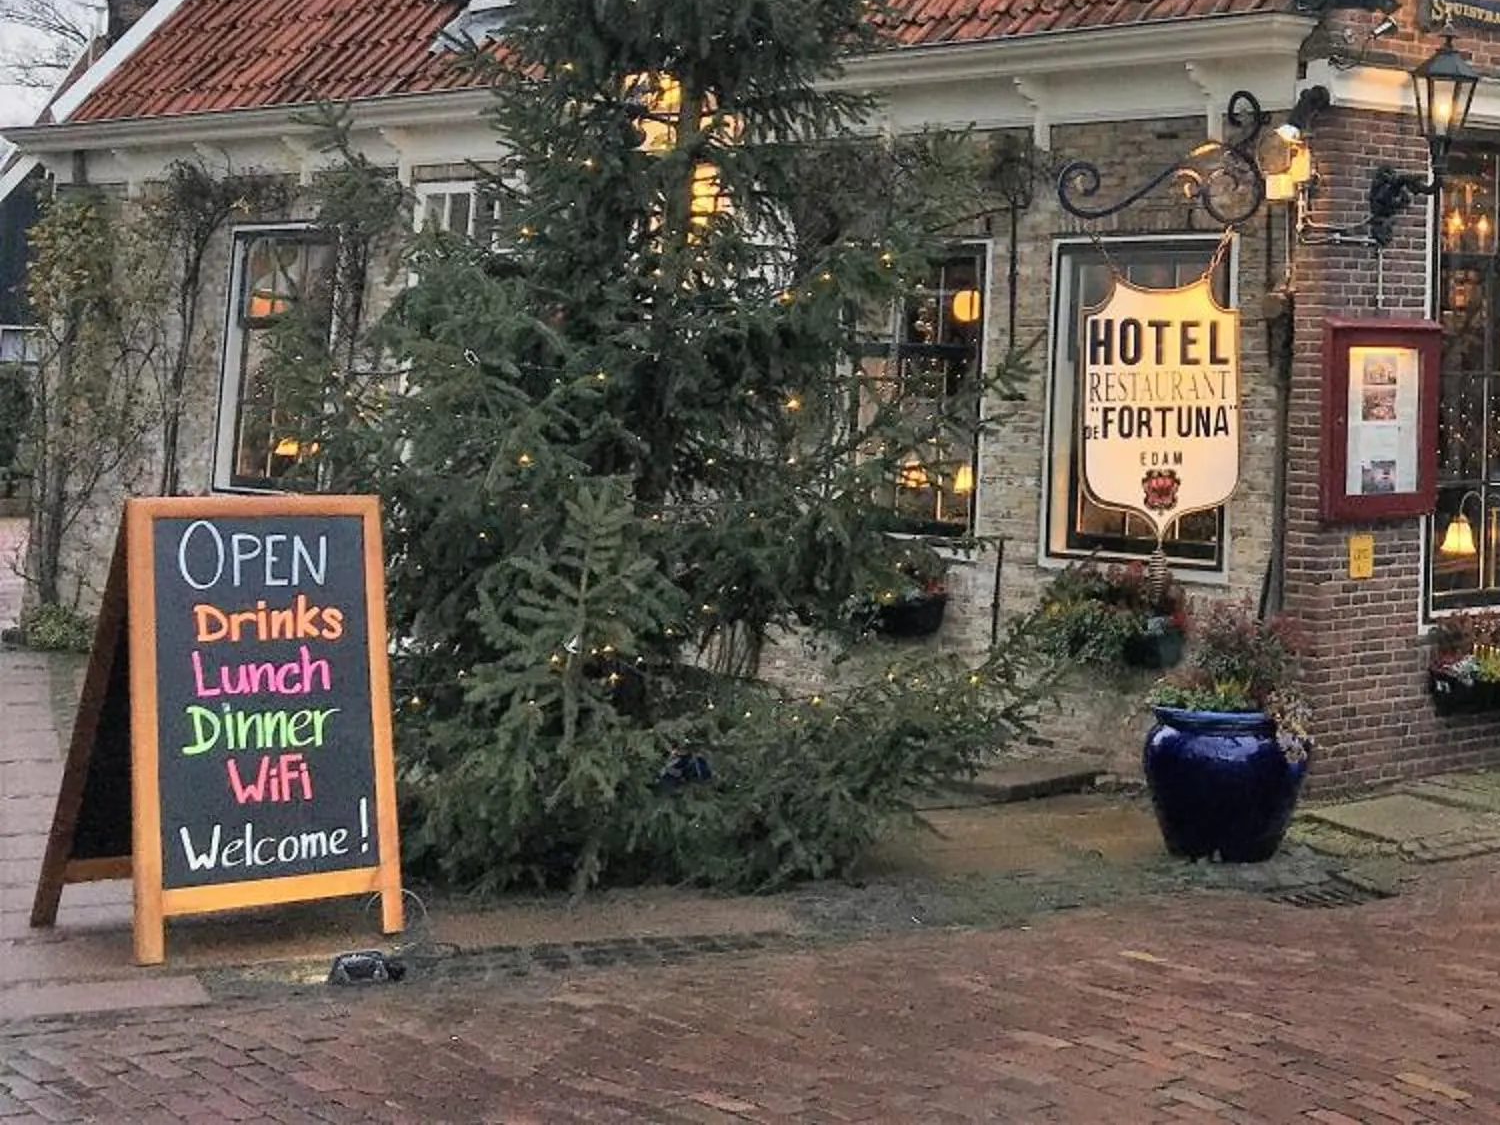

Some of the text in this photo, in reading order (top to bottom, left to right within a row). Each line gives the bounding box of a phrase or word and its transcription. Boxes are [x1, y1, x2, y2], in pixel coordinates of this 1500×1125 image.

[1089, 318, 1230, 366] HOTEL
[1089, 371, 1231, 403] RESTAURANT
[1140, 451, 1183, 466] EDAM
[178, 520, 328, 589] OPEN
[193, 594, 344, 643] Drinks
[191, 645, 332, 697] Lunch
[181, 702, 340, 755] Dinner
[226, 753, 313, 804] WiFi
